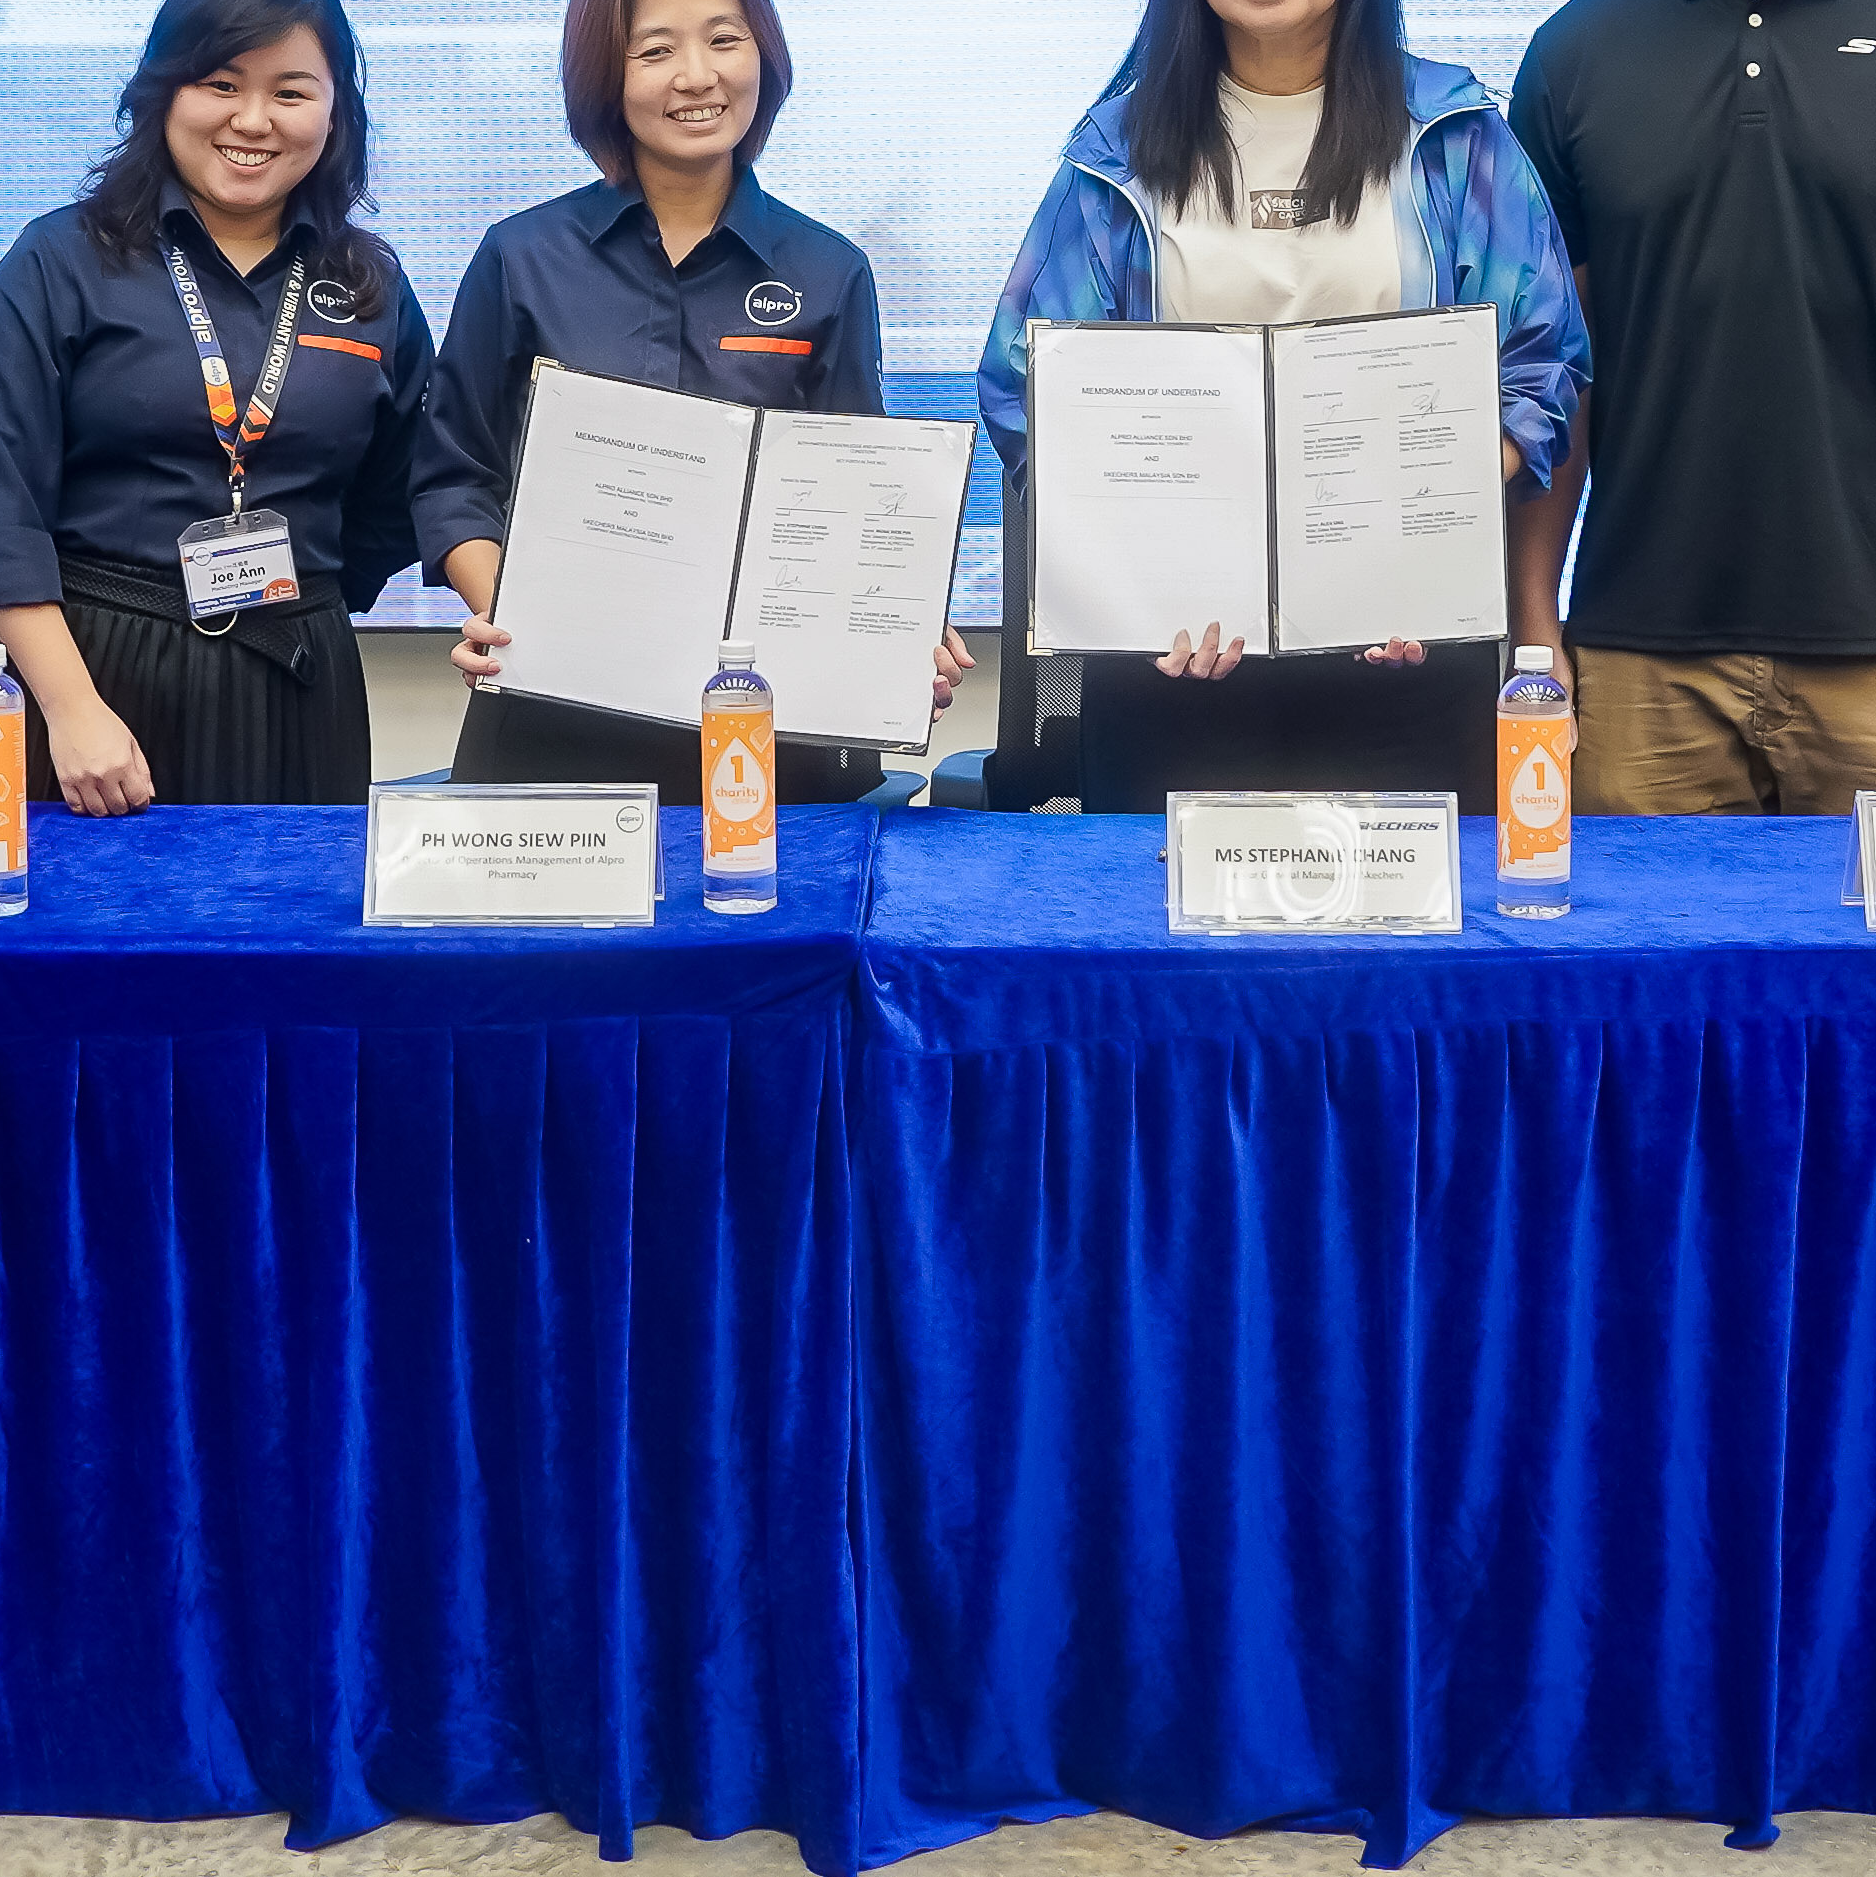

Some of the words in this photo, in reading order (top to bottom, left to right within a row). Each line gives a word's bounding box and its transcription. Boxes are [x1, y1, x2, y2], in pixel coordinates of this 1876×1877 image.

[751, 297, 794, 313] alpro
[182, 292, 213, 344] alpro
[275, 290, 300, 345] VIBRANT
[261, 343, 289, 395] WORLD
[1082, 387, 1146, 396] MEMORANDUM
[1147, 388, 1159, 396] OF
[1161, 388, 1221, 397] UNDERSTAND
[211, 572, 234, 585] Joe
[239, 566, 266, 580] Ann
[731, 755, 743, 783] 1
[1533, 762, 1545, 790] 1
[715, 786, 759, 803] charity
[1515, 793, 1559, 810] charity
[421, 833, 445, 847] PH
[452, 833, 513, 848] WONG
[518, 832, 565, 848] SIEW
[570, 832, 607, 848] PIIN
[458, 855, 513, 866] Operations
[515, 855, 582, 867] Management
[584, 855, 596, 865] of
[597, 855, 625, 866] Alpro
[1215, 848, 1243, 863] MS
[488, 870, 538, 881] Pharmacy
